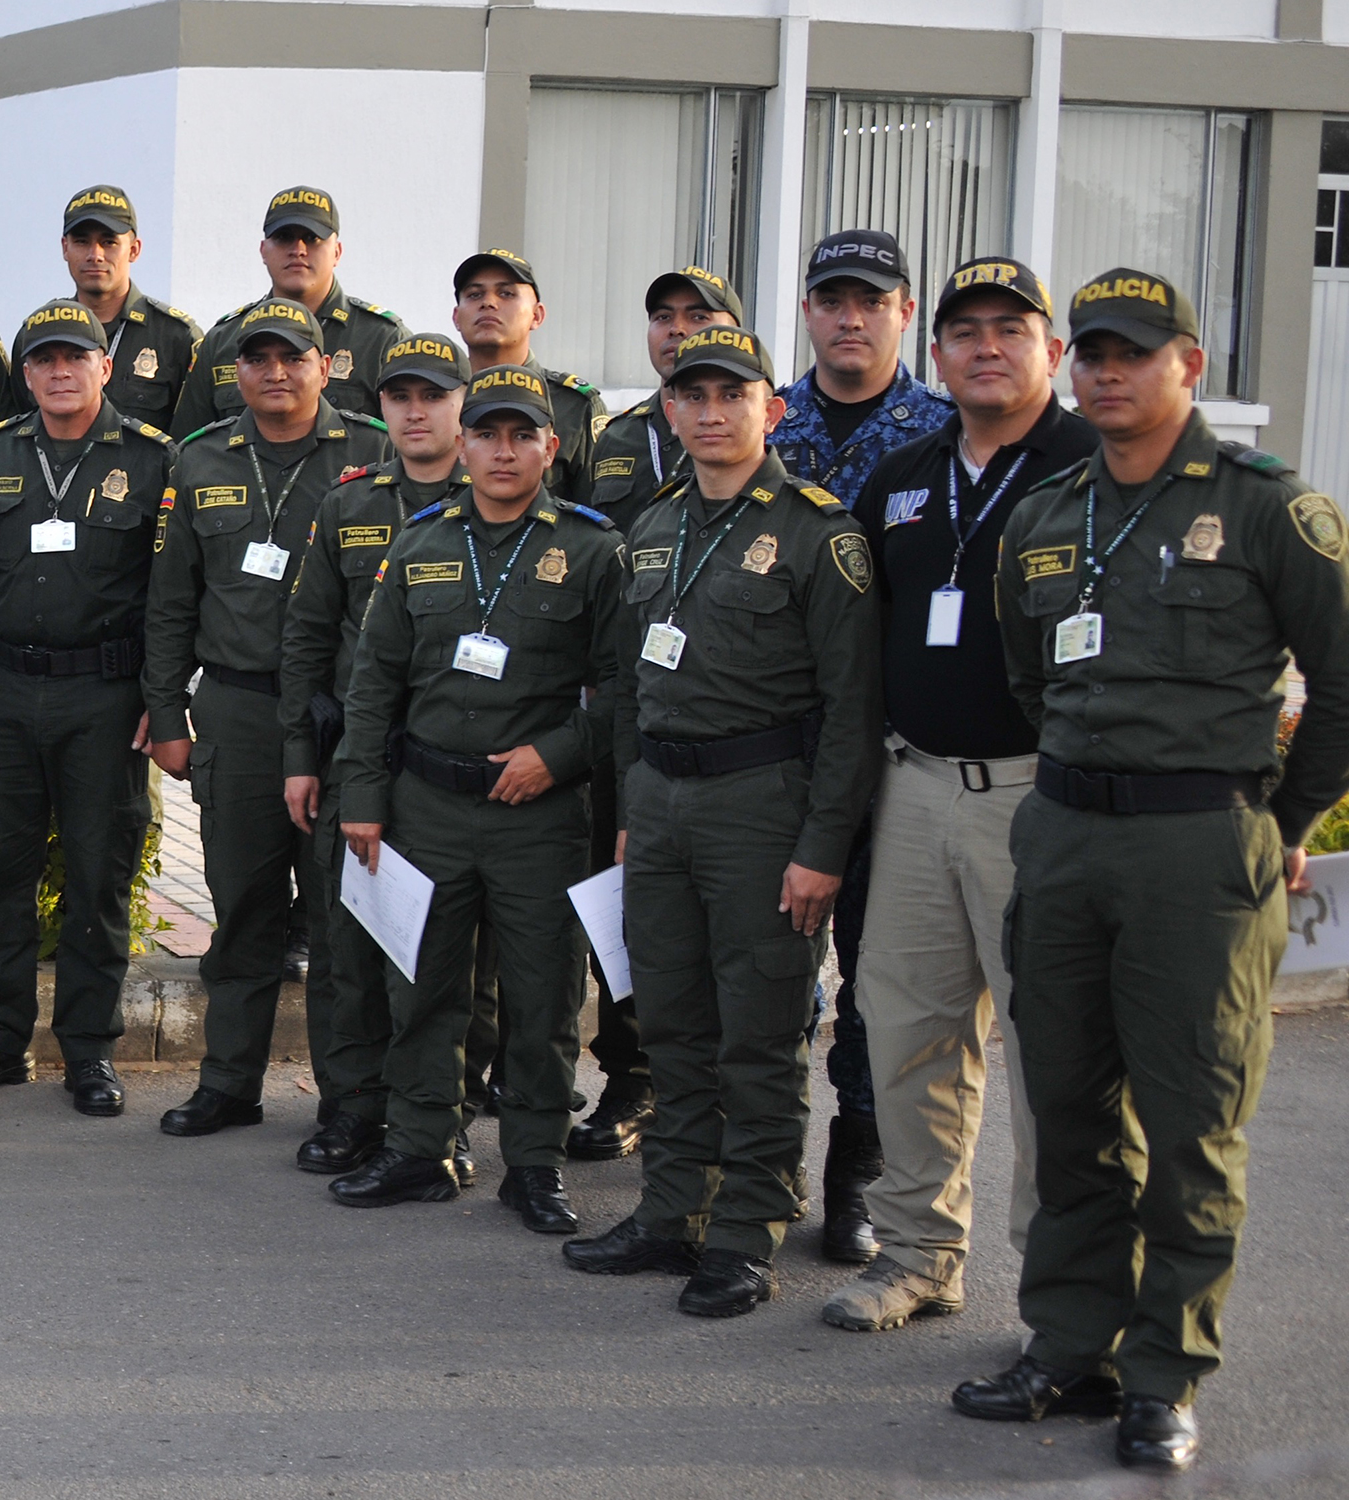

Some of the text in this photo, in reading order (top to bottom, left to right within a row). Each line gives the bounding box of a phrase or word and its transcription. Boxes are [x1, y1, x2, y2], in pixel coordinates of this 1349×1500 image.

[68, 191, 128, 212] POLICIA
[271, 190, 330, 212] POLICIA
[815, 243, 895, 266] INPEC
[954, 262, 1019, 290] UNP
[1073, 278, 1168, 310] POLICIA
[26, 307, 91, 331] POLICIA
[241, 304, 307, 329] POLICIA
[386, 339, 455, 364] POLICIA
[677, 329, 755, 358] POLICIA
[471, 370, 544, 396] POLICIA
[885, 487, 930, 523] UNP
[419, 565, 447, 573] Patrullero
[1038, 561, 1064, 573] MORA
